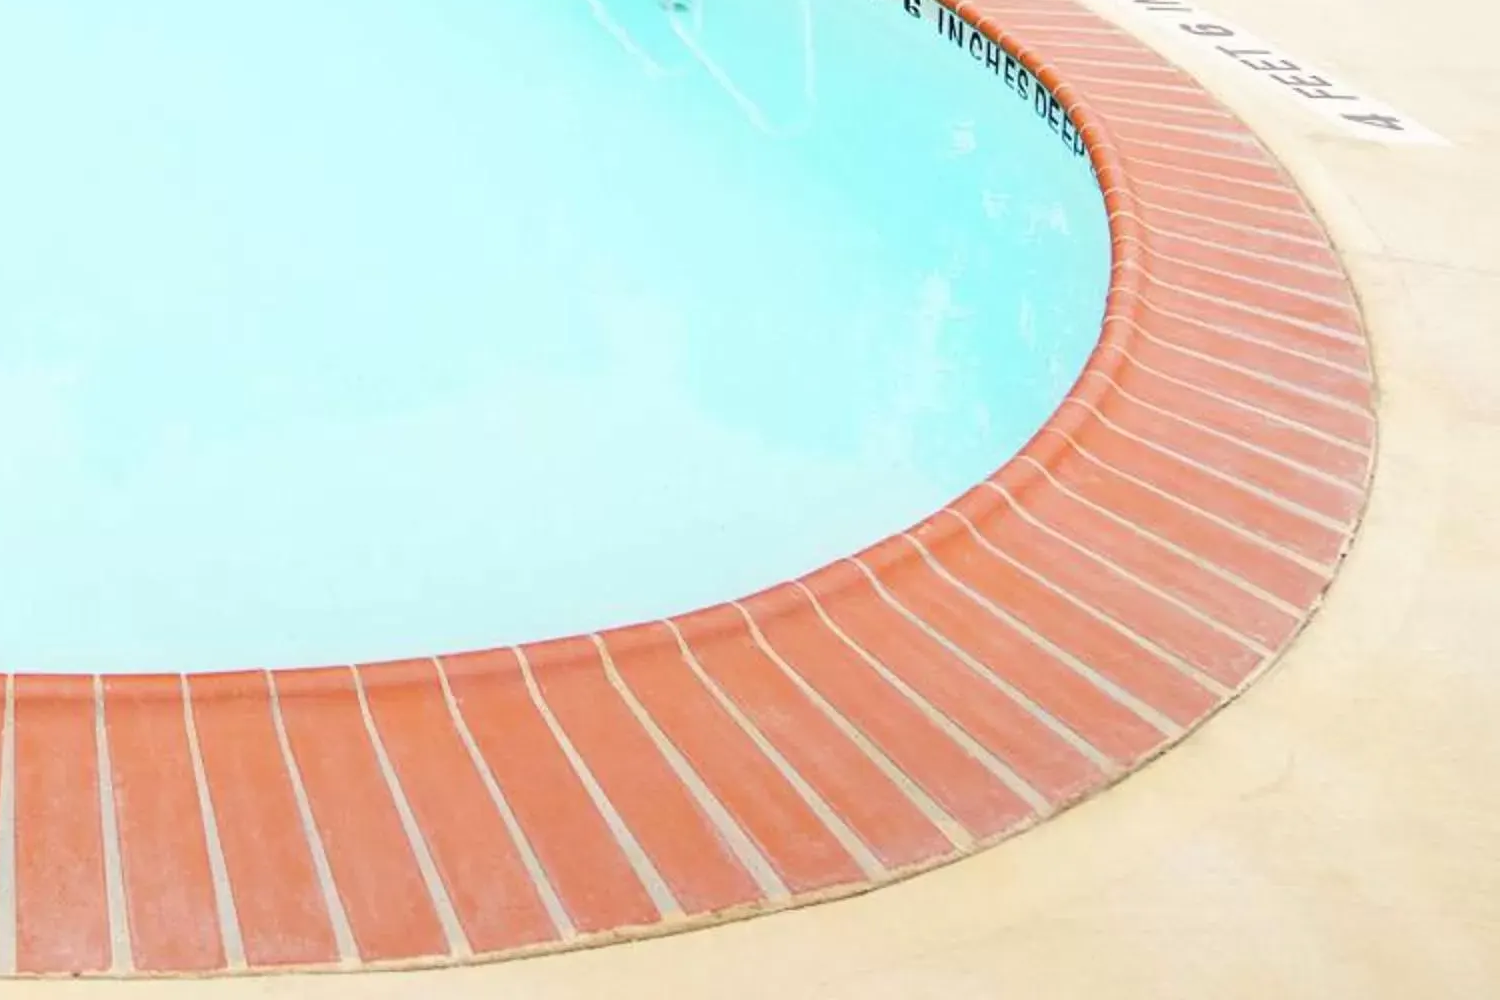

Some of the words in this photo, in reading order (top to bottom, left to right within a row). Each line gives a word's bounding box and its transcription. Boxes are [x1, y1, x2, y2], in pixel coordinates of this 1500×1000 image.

[1179, 22, 1235, 39] 6
[937, 7, 1029, 101] INCHES
[1215, 44, 1360, 101] FEET
[1342, 112, 1405, 131] 4
